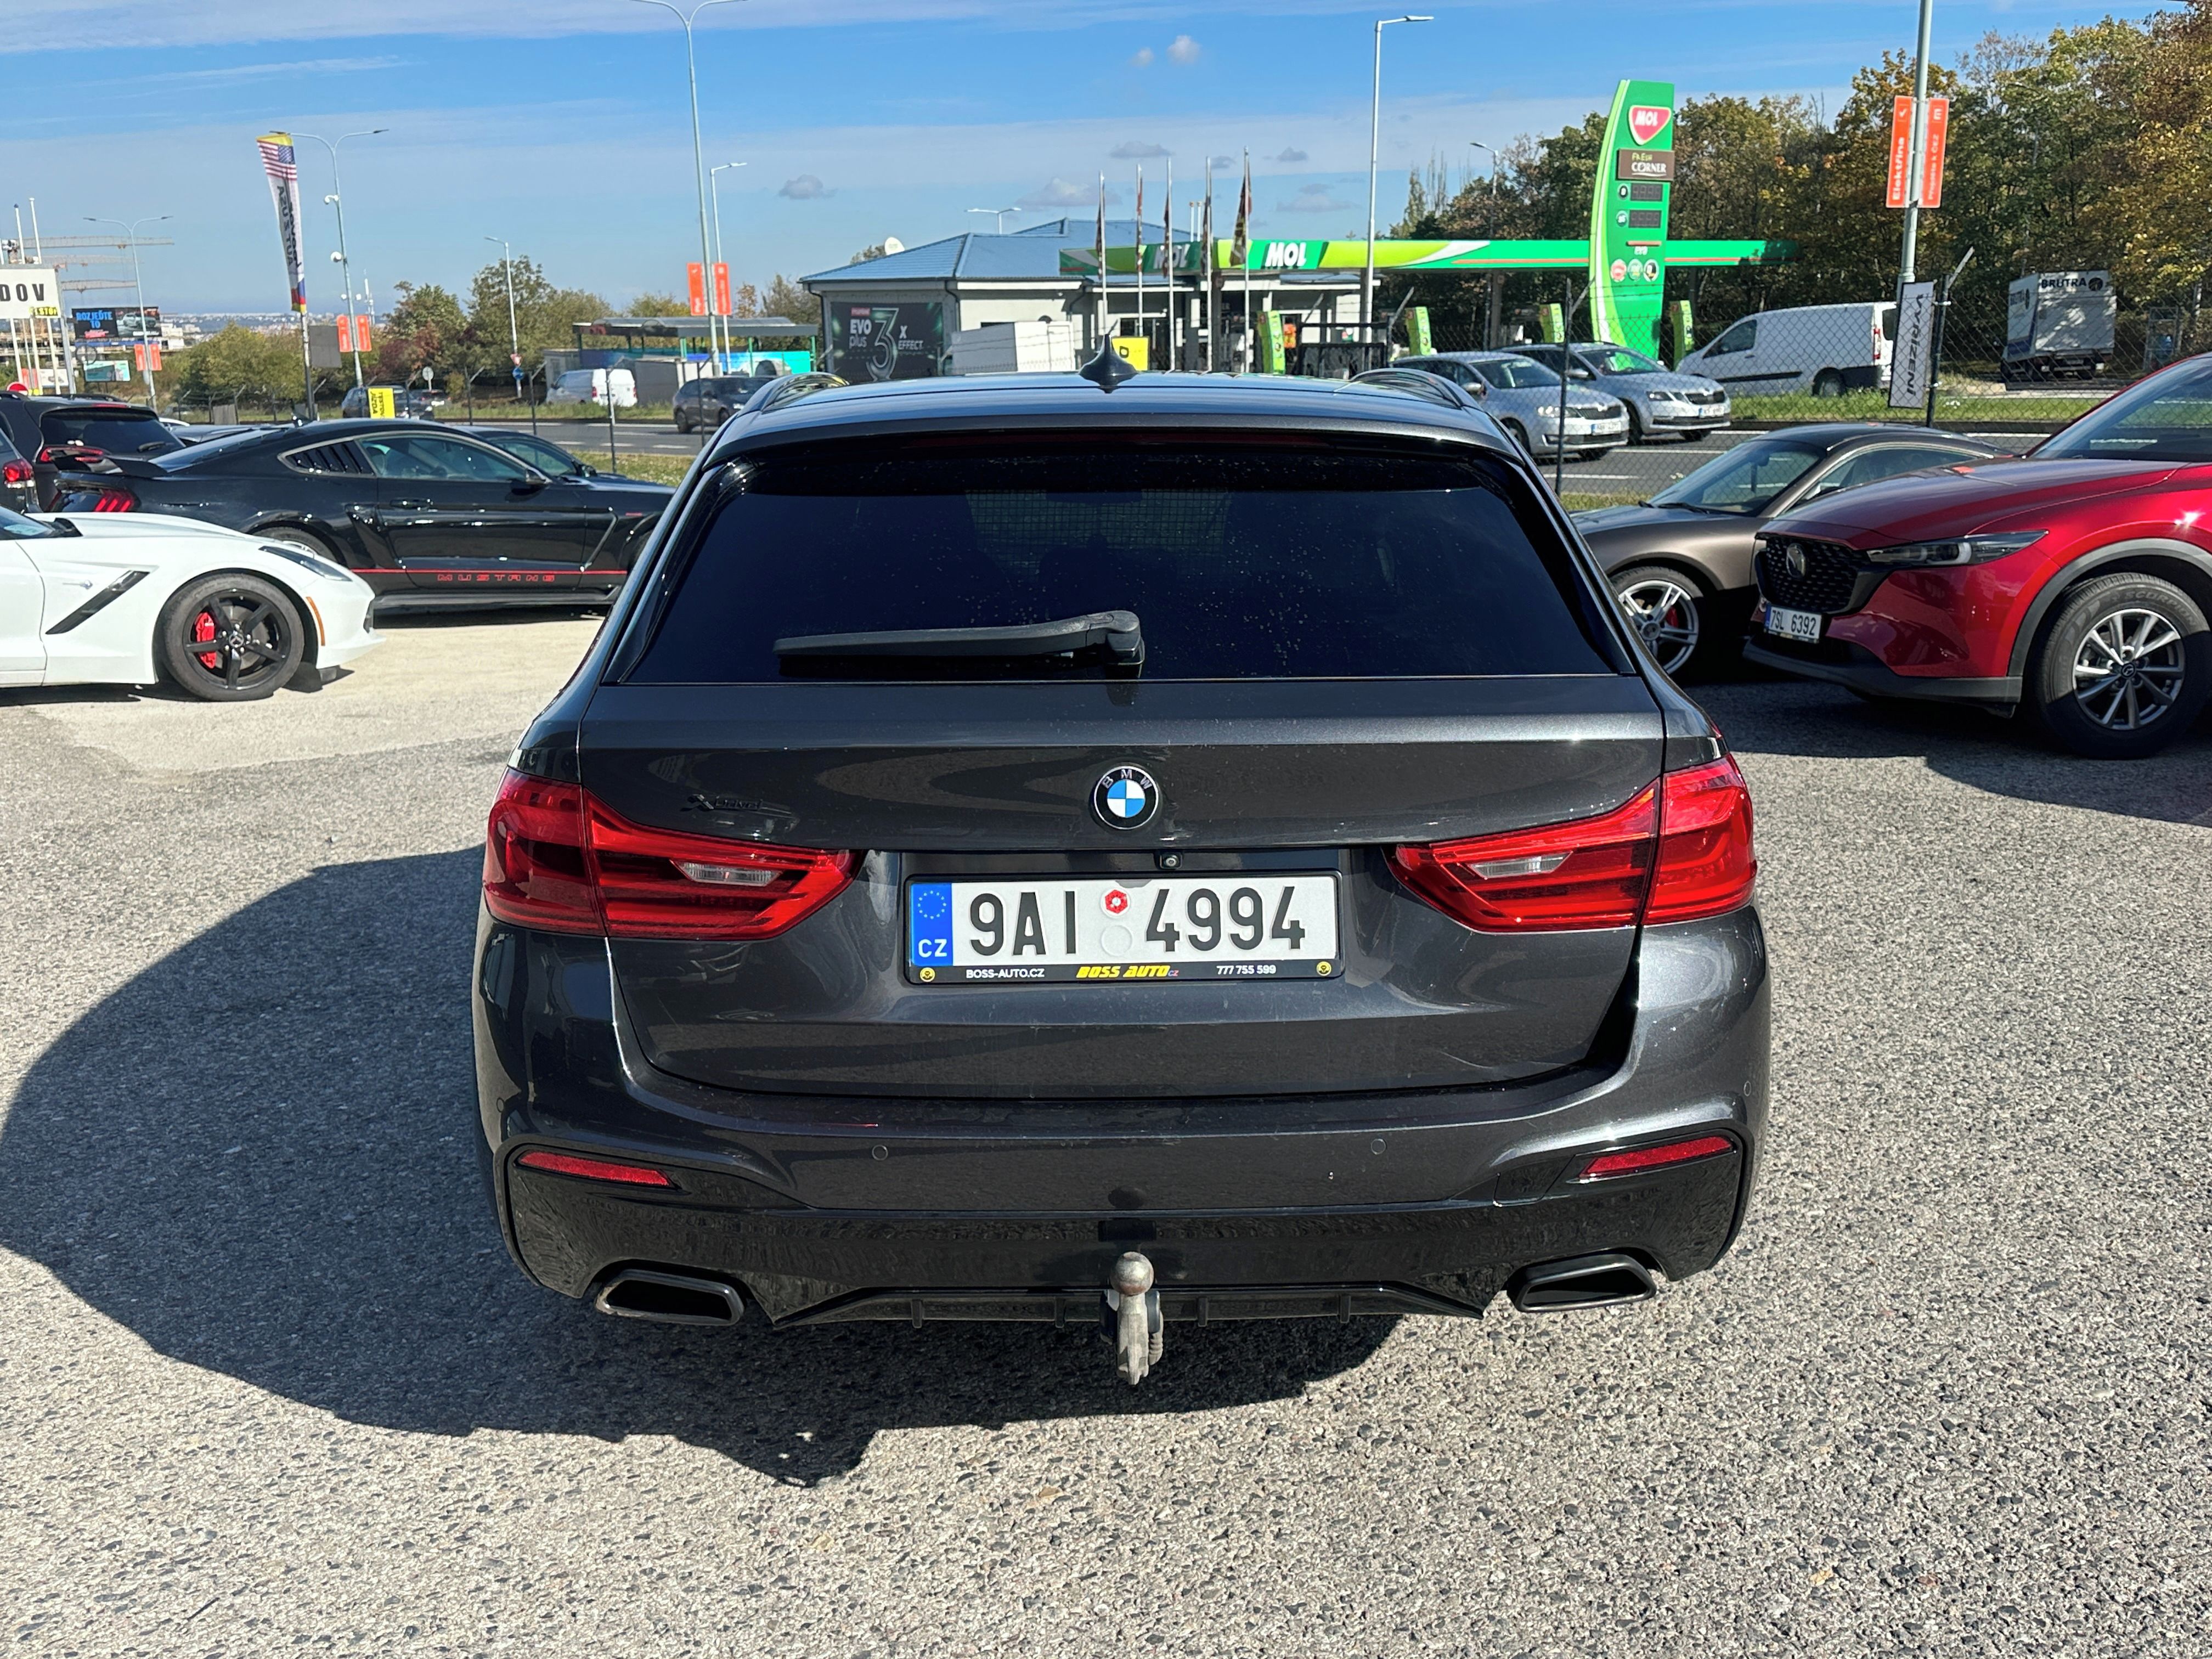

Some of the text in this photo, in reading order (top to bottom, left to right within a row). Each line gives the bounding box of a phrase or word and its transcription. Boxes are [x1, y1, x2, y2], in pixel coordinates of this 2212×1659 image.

[1635, 110, 1659, 127] MOL
[1631, 161, 1667, 173] CORNER
[1265, 241, 1307, 267] MOL
[2041, 278, 2087, 289] BRUTRA
[850, 319, 872, 335] EVO
[849, 334, 867, 348] plus
[898, 340, 924, 350] EFFECT
[437, 573, 555, 583] MUSTANG
[2124, 590, 2196, 627] SCORPION
[1770, 610, 1784, 631] 7SL
[1791, 614, 1816, 636] 6392
[1101, 769, 1153, 789] BMW
[969, 886, 1306, 956] 9AI 4994
[918, 939, 947, 958] CZ
[966, 968, 1045, 979] BOSS-AUTO.CZ
[1076, 966, 1121, 979] BOSS
[1122, 964, 1171, 978] AUTO
[1216, 964, 1277, 975] 777 755 599
